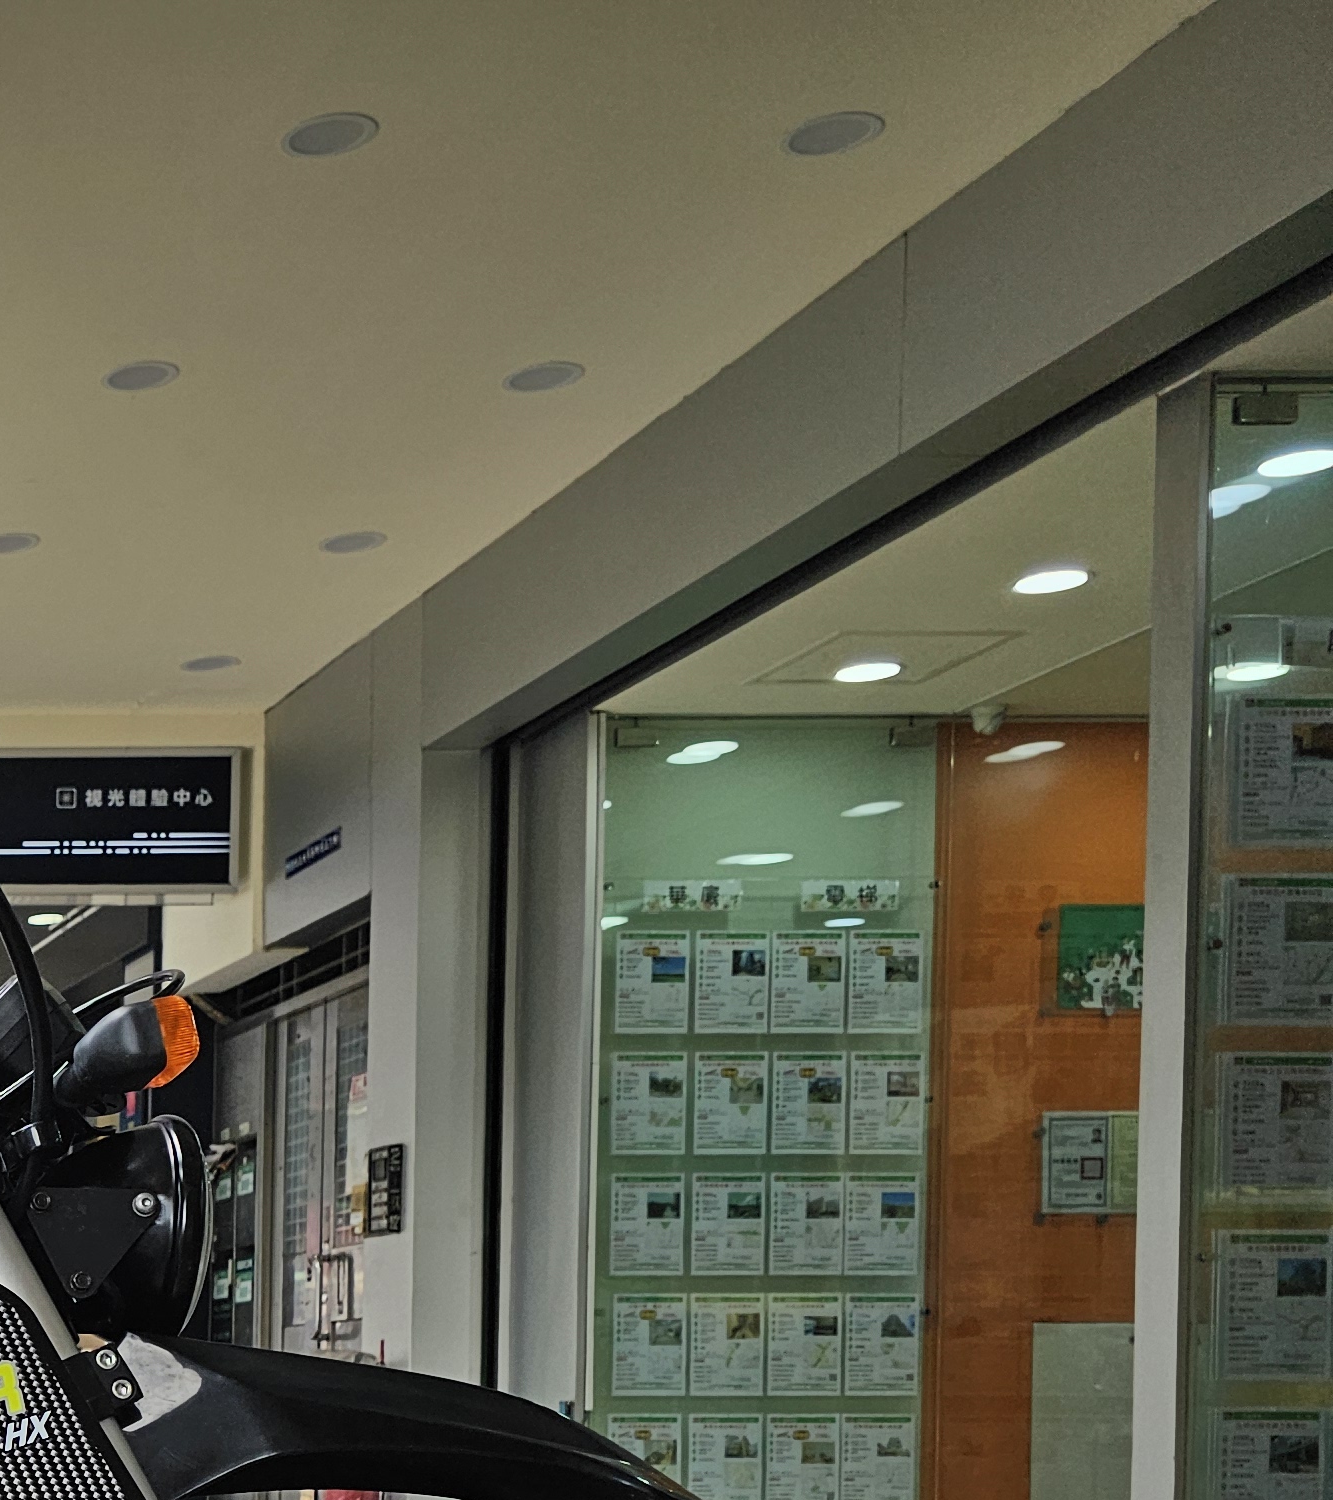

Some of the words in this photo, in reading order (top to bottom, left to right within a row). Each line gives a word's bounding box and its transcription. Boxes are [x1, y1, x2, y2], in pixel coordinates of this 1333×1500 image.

[85, 788, 213, 808] 視光體驗中心
[4, 1410, 51, 1452] HX
